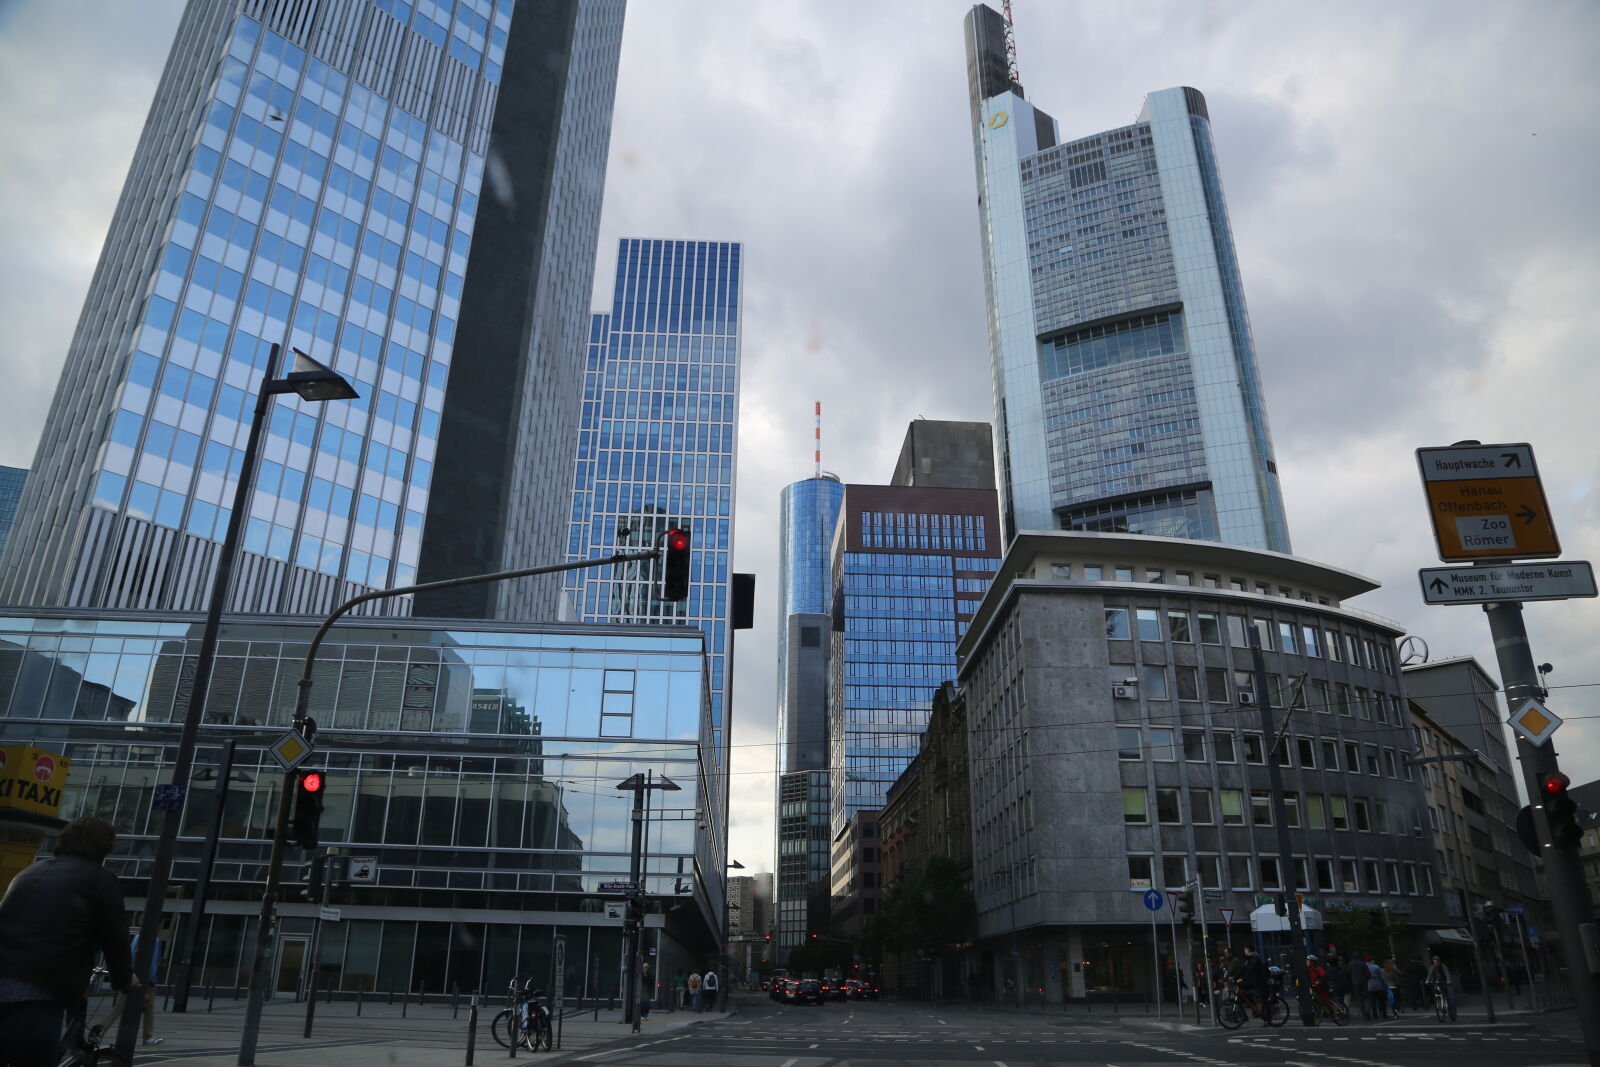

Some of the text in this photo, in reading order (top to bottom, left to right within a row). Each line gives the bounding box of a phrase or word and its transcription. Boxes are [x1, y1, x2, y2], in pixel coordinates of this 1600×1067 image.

[1435, 458, 1495, 472] Hauptwache
[1460, 486, 1503, 496] Hanau
[1439, 500, 1507, 513] Offenbach
[1481, 519, 1507, 530] Zoo
[1464, 534, 1509, 546] Römer
[1450, 573, 1487, 583] Museum
[1506, 569, 1545, 579] Moderne
[1547, 569, 1573, 578] Kunst
[1453, 586, 1475, 596] MMK
[1490, 584, 1534, 595] Taunustor
[17, 778, 61, 807] TAXI
